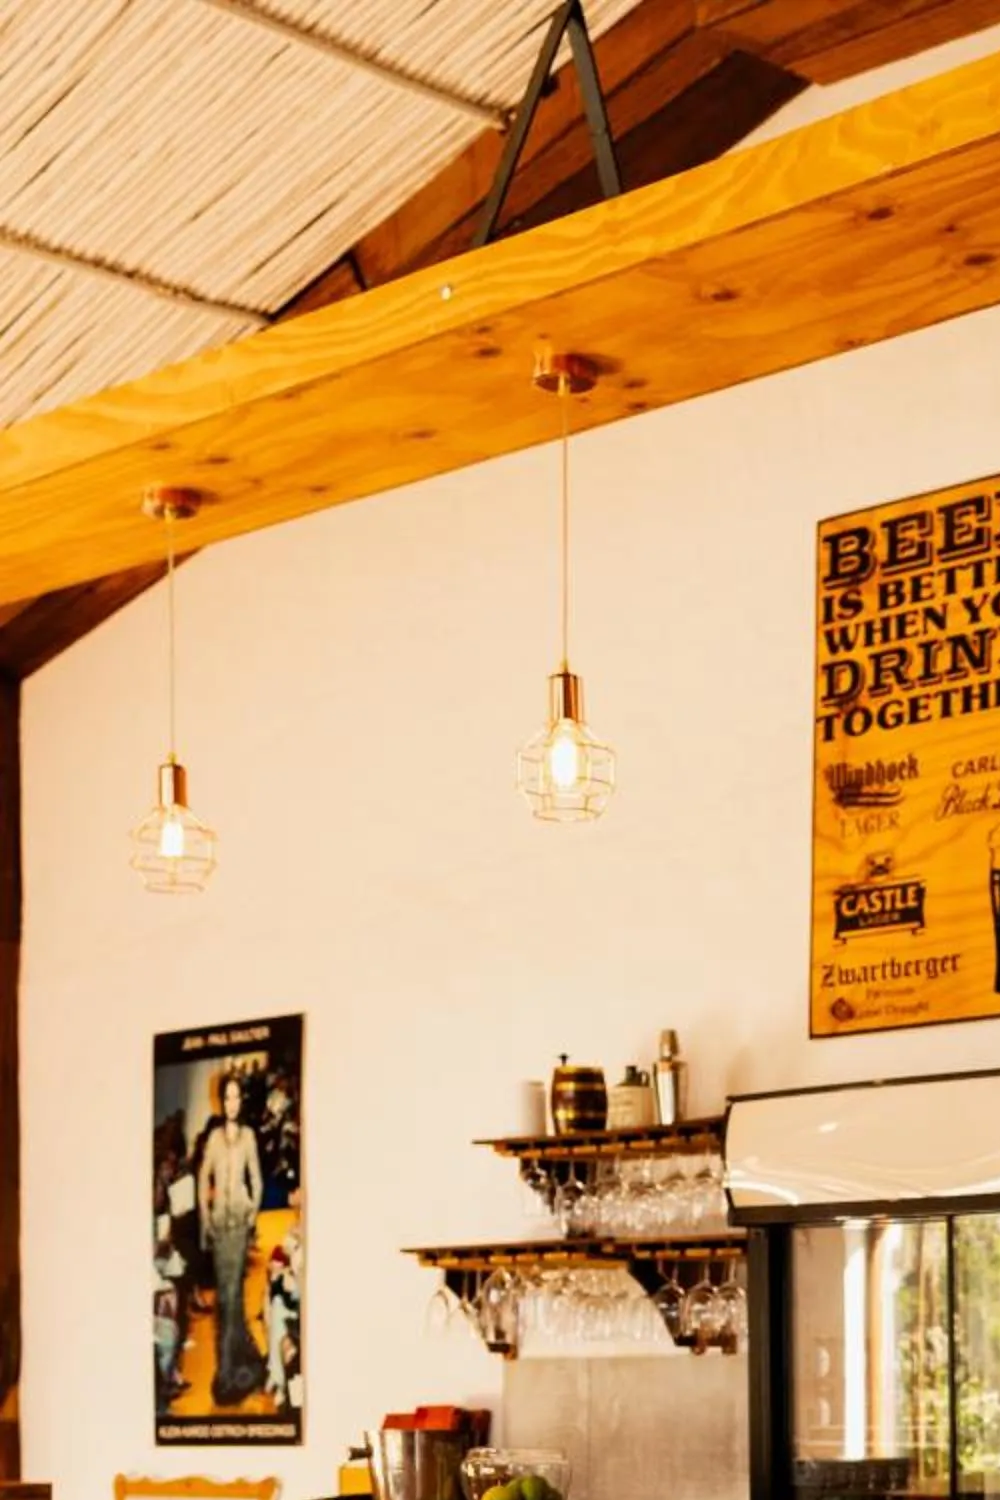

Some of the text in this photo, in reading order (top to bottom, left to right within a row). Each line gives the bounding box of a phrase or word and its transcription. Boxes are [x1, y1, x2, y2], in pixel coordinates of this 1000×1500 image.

[822, 588, 864, 625] IS
[824, 603, 948, 656] WHEN
[840, 885, 919, 917] CASTLE
[820, 953, 961, 989] Zwartberger
